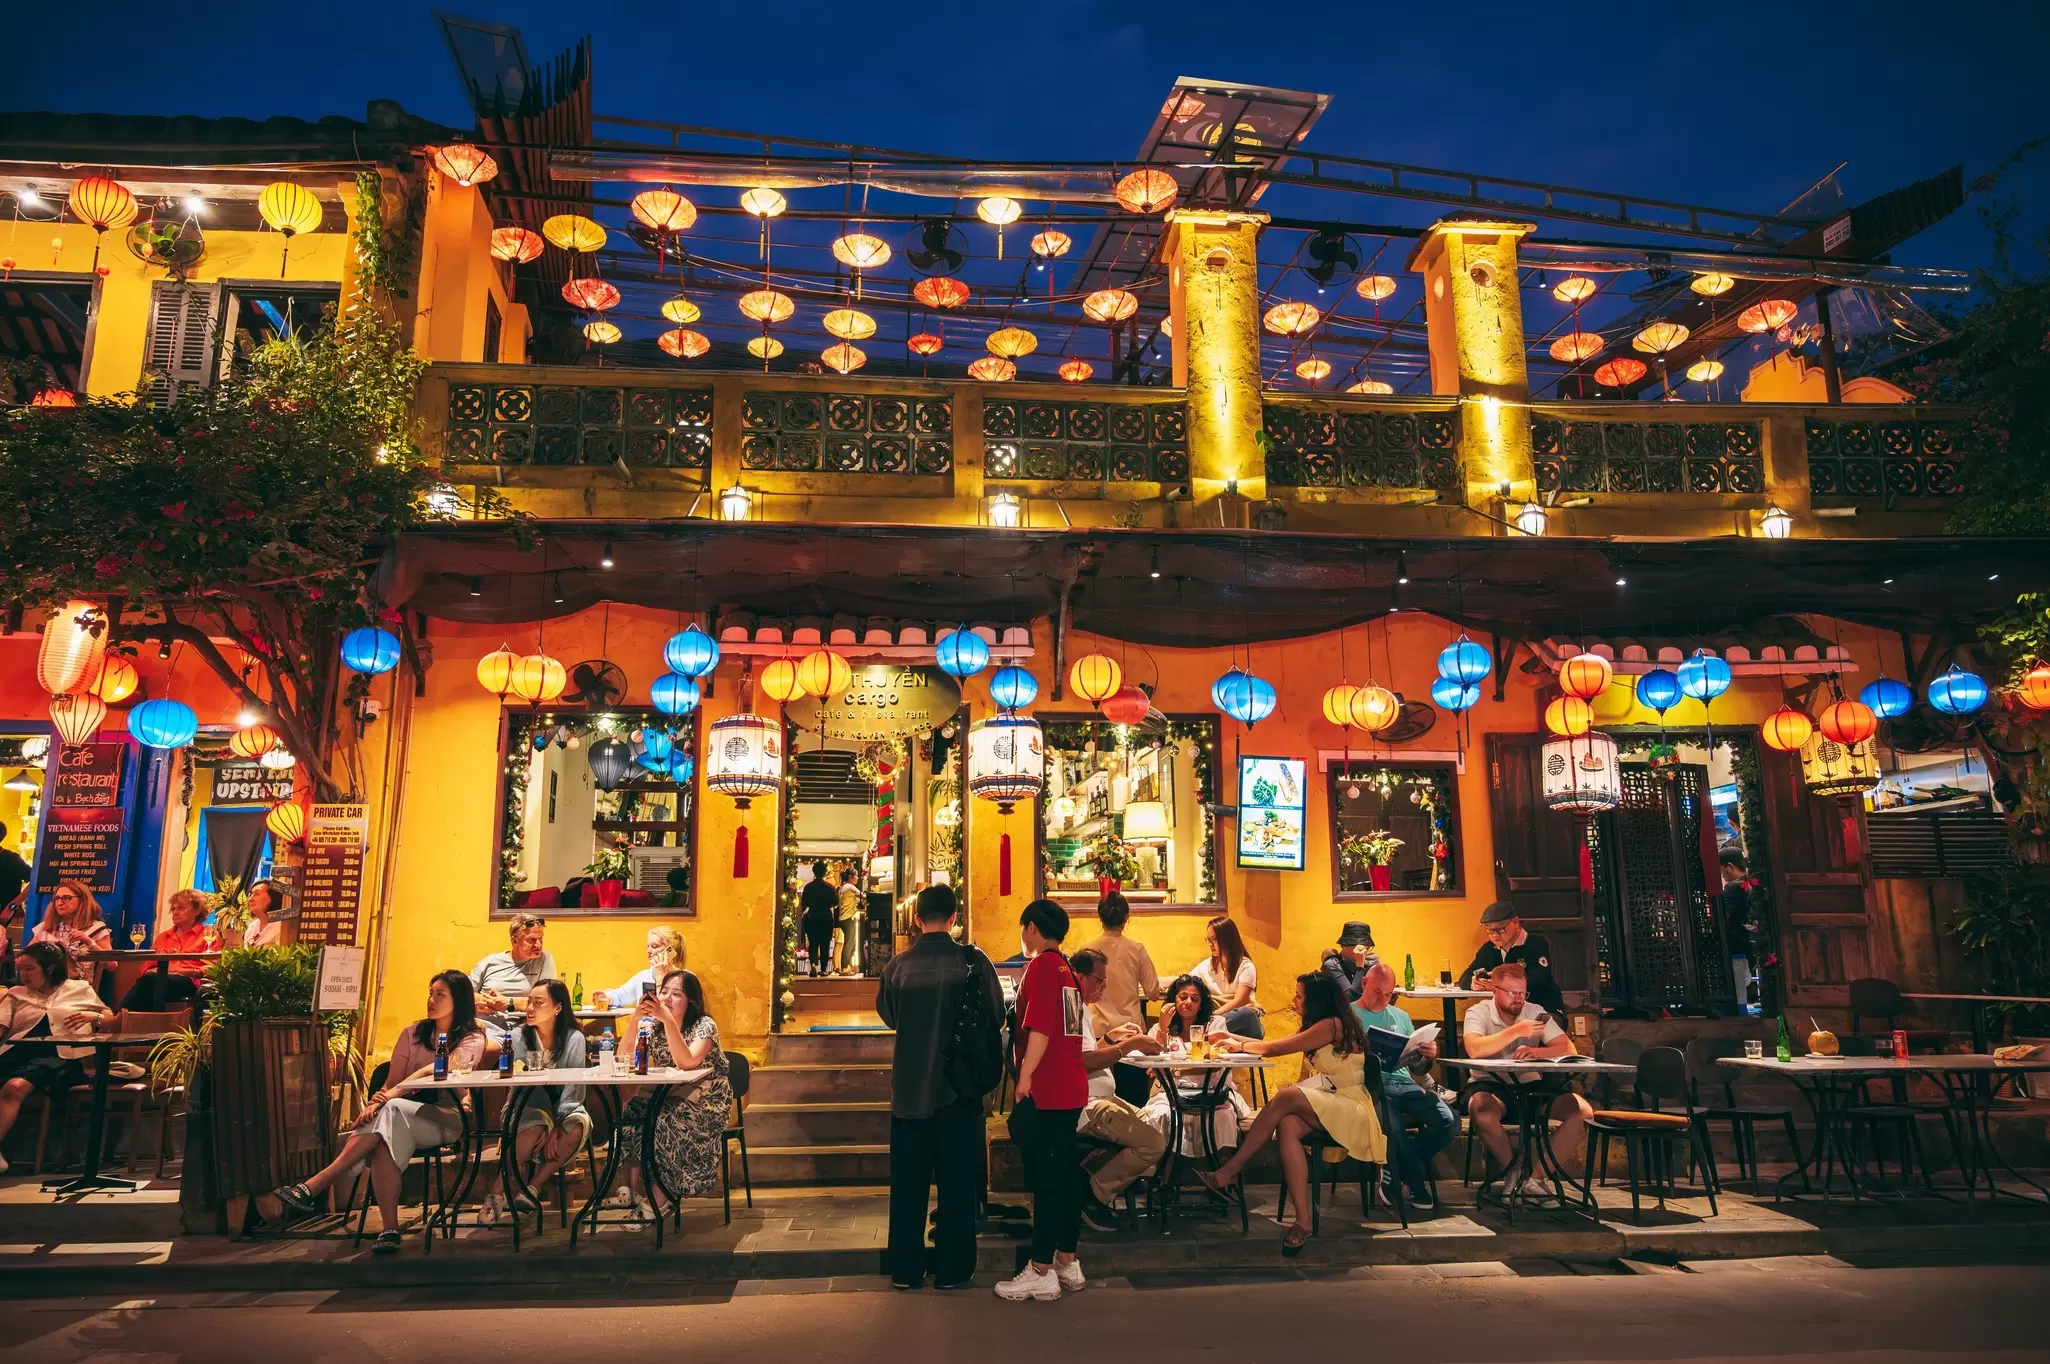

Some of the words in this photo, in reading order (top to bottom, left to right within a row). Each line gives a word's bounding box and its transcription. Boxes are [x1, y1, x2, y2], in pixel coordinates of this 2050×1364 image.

[845, 692, 899, 708] cargo
[815, 709, 842, 719] cafe
[847, 710, 855, 719] &
[862, 709, 930, 719] restarant
[60, 747, 94, 768] Cafe
[57, 772, 117, 788] restaurant
[216, 782, 294, 799] UPSTAIR
[313, 807, 345, 818] PRIVATE
[346, 807, 363, 818] CAR
[47, 824, 93, 832] VIETNAMESE
[93, 824, 119, 832] FOODS
